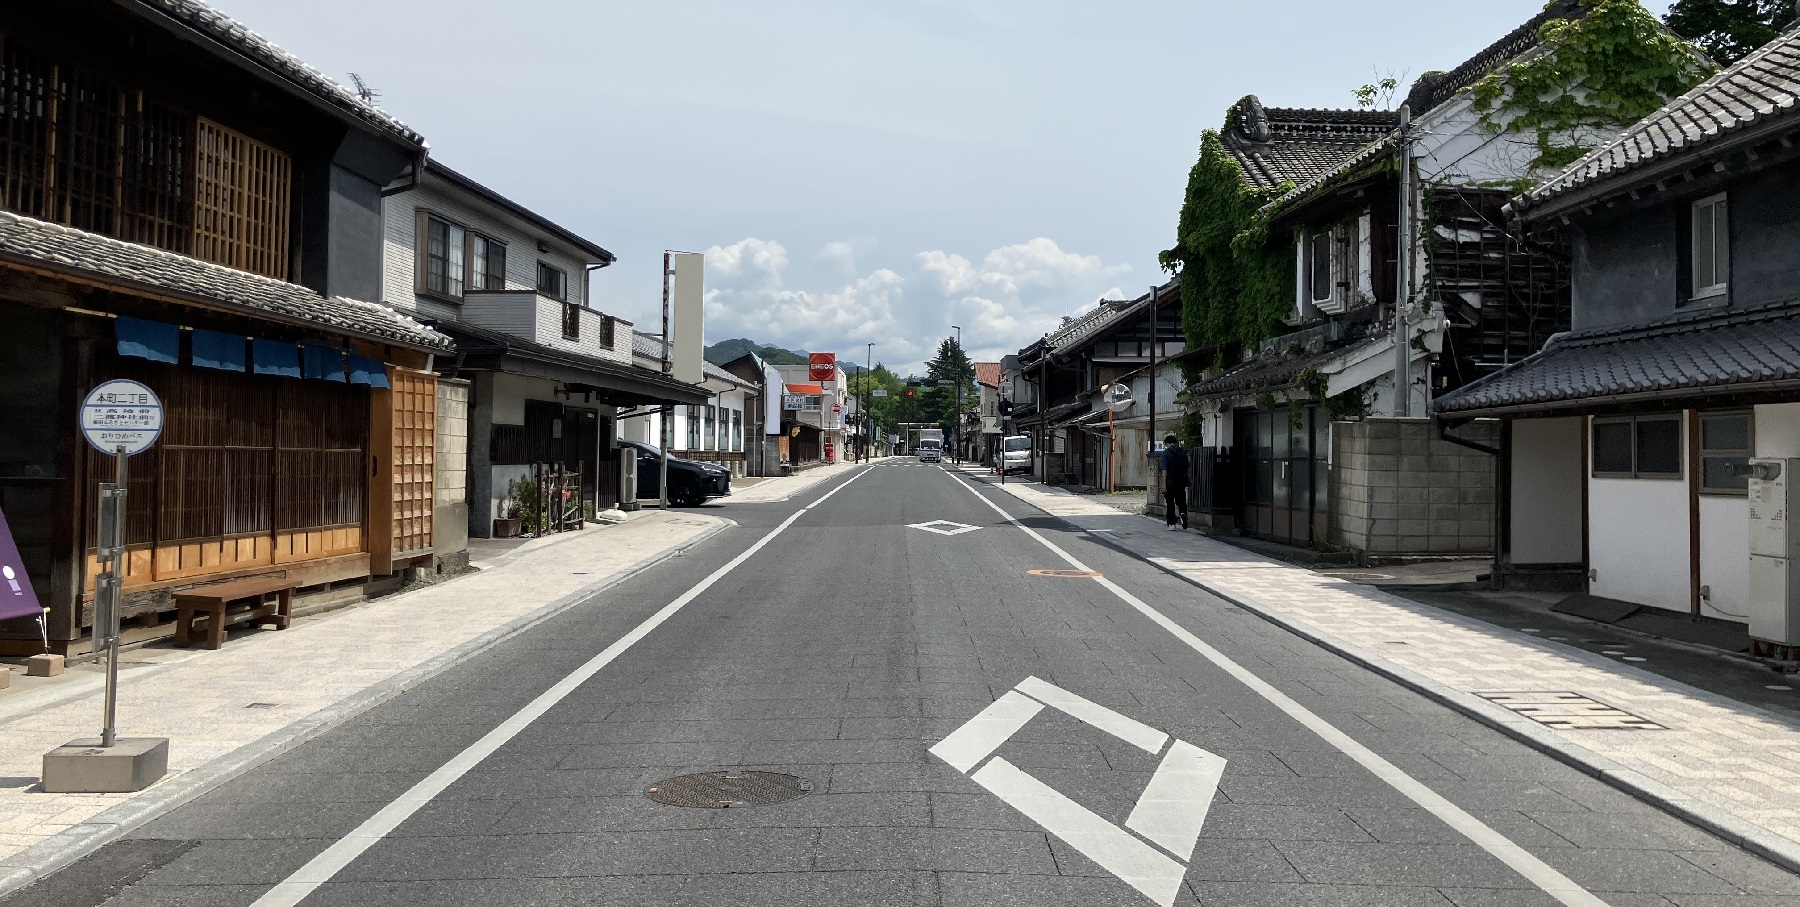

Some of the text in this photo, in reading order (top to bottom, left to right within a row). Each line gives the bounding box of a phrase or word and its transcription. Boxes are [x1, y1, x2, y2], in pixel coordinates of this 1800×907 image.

[96, 393, 148, 404] 本町二丁目
[100, 432, 143, 440] おりひめバス
